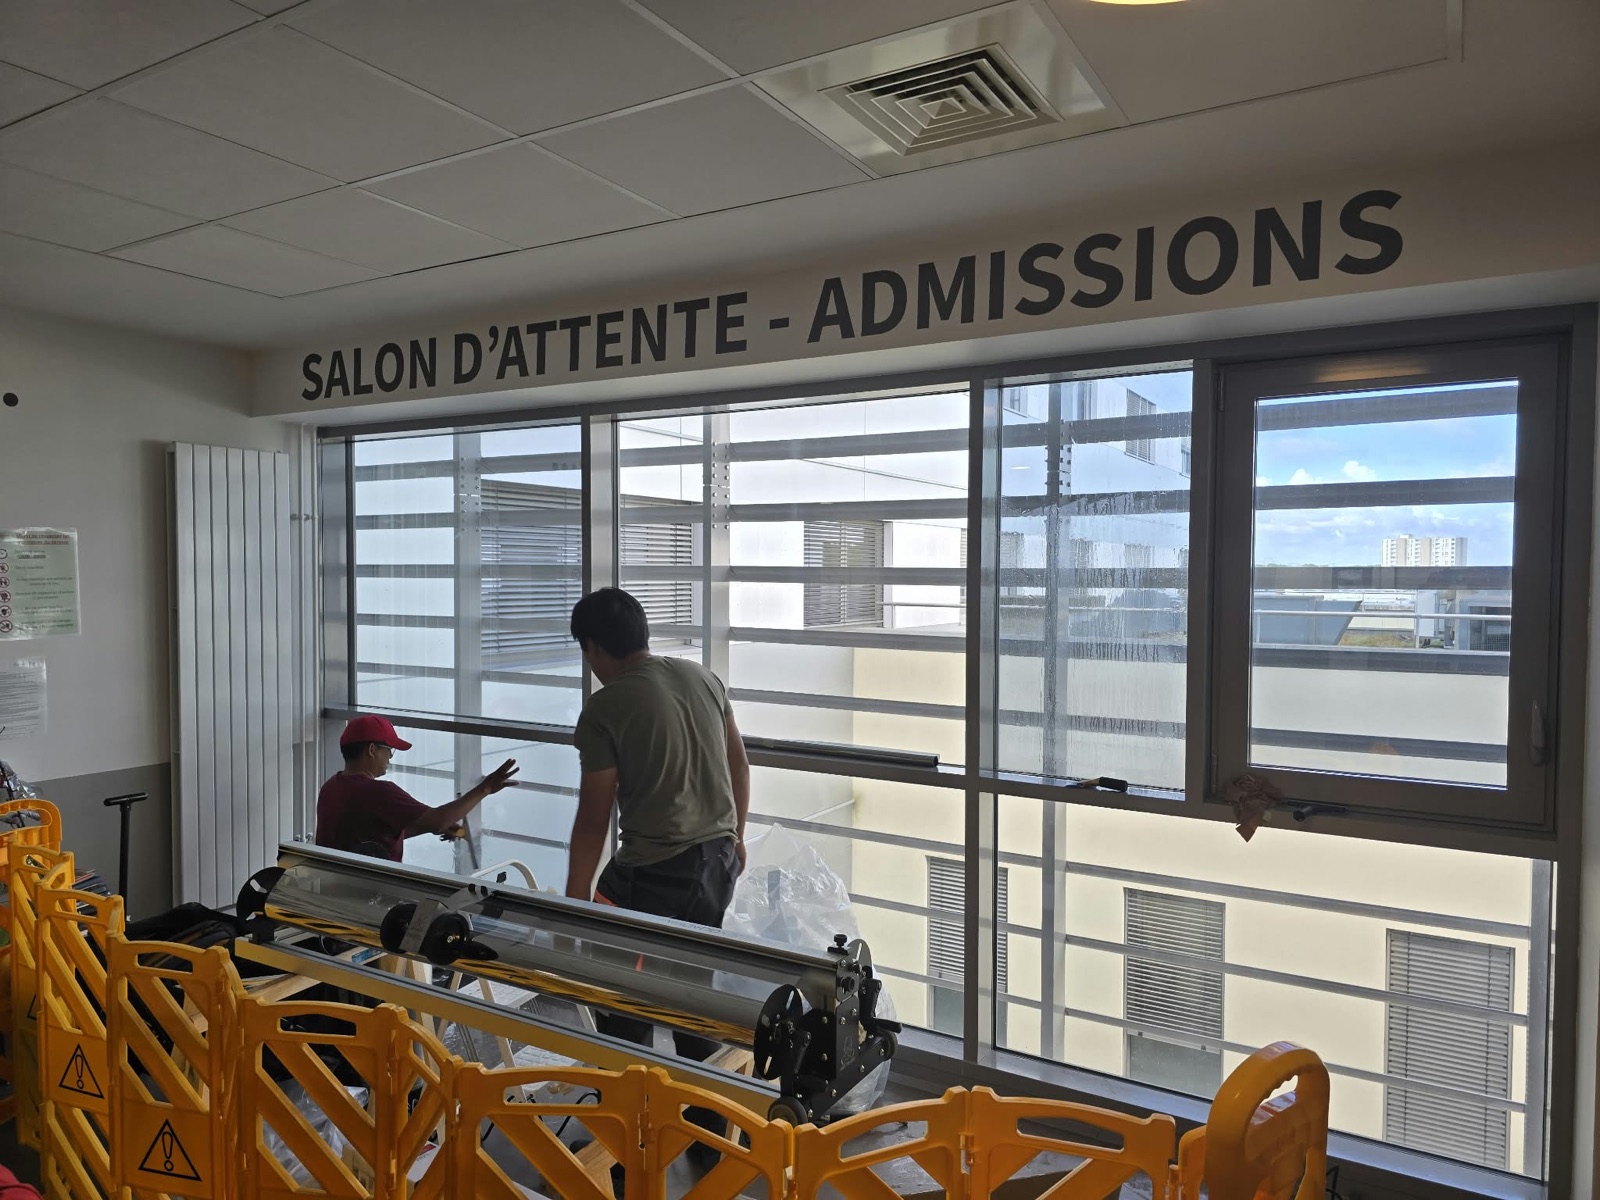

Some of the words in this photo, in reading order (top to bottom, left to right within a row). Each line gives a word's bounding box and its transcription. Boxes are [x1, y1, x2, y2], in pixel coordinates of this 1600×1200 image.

[302, 337, 437, 402] SALON
[453, 291, 748, 385] D’ATTENTE
[769, 317, 790, 330] -
[807, 190, 1404, 344] ADMISSIONS
